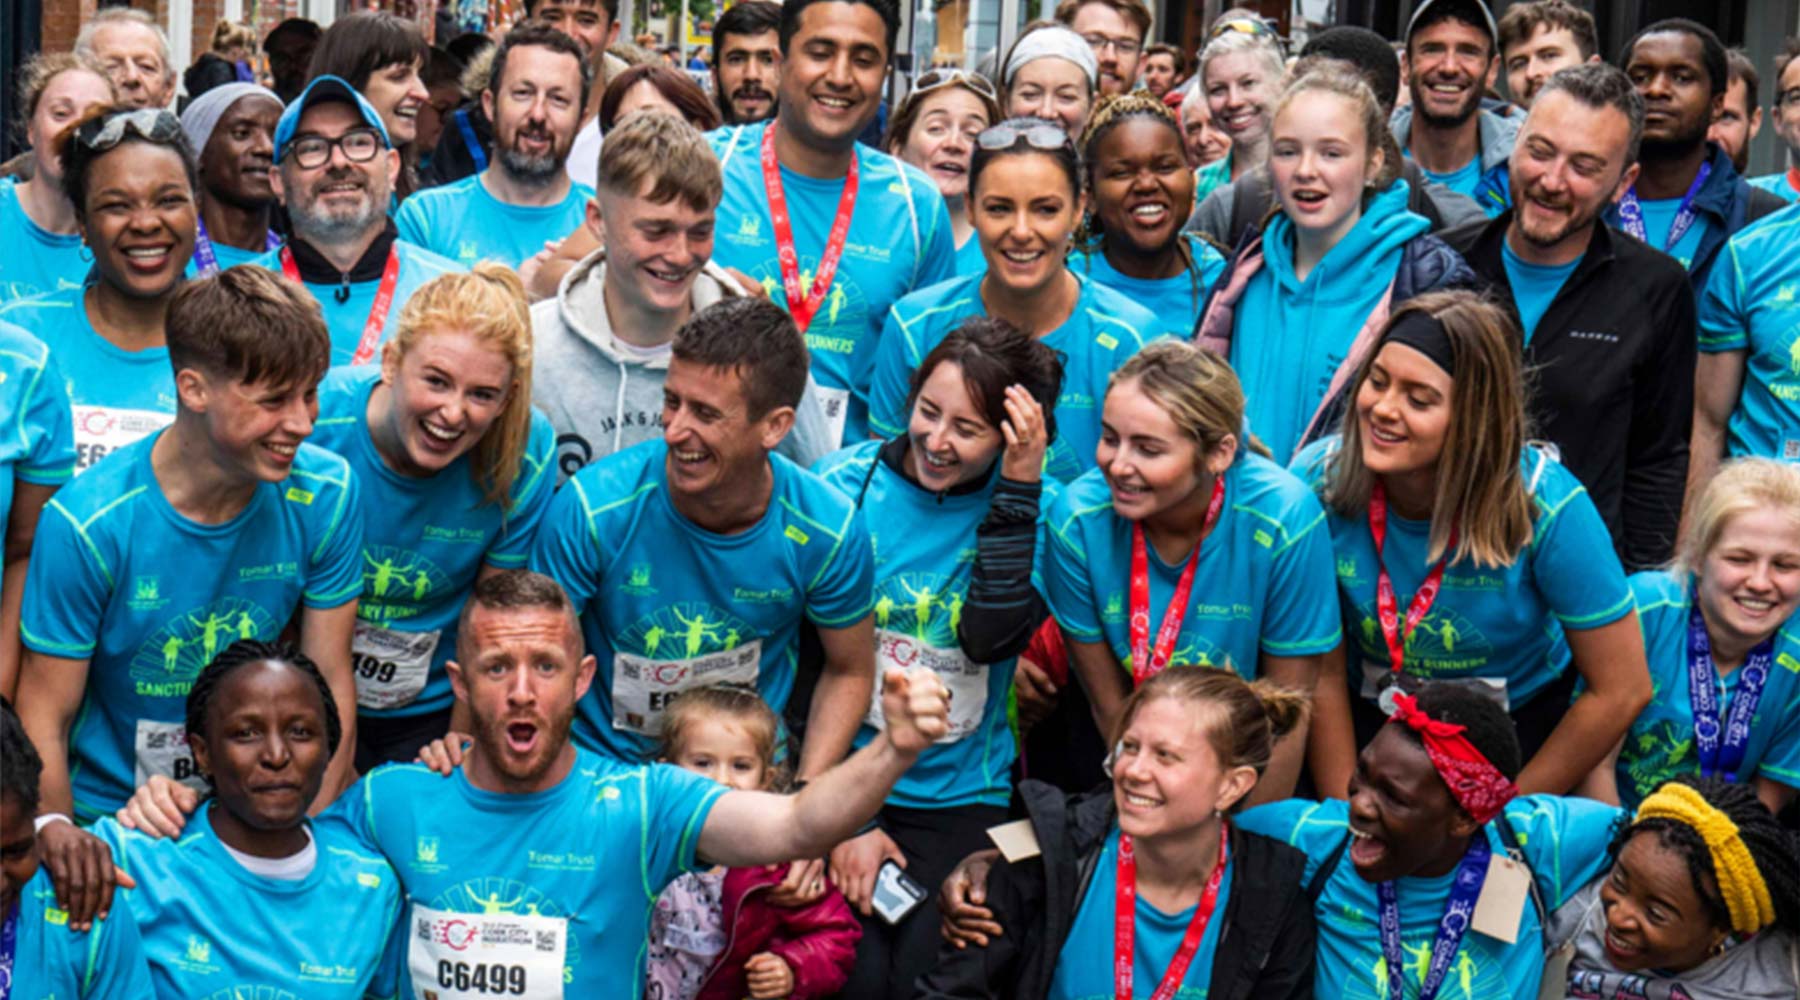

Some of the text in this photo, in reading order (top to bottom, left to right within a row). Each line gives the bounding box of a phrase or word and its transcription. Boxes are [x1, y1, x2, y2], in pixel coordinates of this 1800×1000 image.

[600, 411, 634, 434] JAK
[528, 851, 596, 865] Tomar Trust
[299, 962, 333, 976] Tomar
[437, 959, 527, 996] C6499
